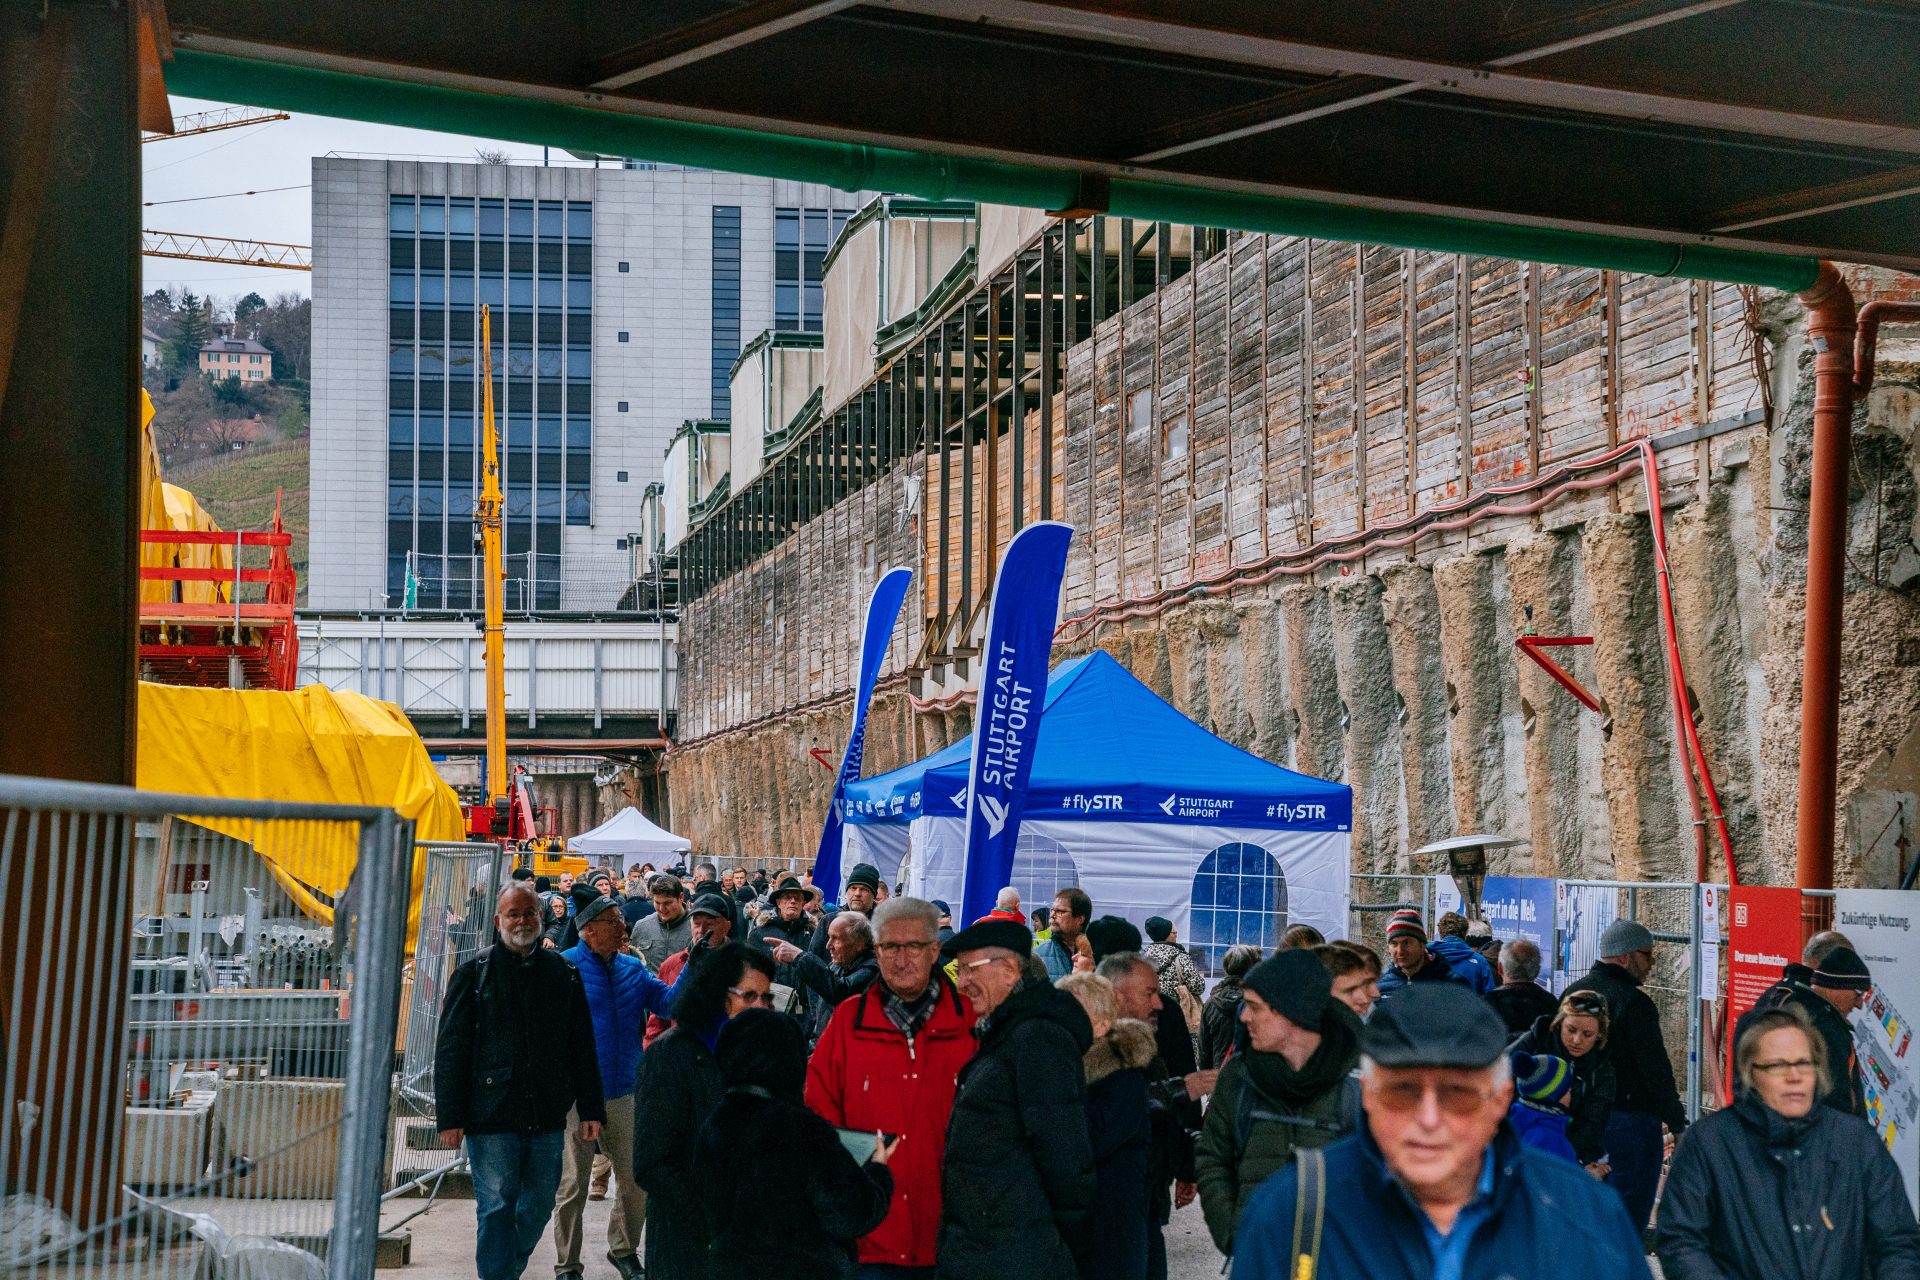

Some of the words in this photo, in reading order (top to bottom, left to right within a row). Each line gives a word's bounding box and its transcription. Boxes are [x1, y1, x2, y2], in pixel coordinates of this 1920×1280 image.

[982, 640, 1016, 786] STUTTGART
[1003, 680, 1033, 790] AIRPORT
[1062, 794, 1123, 813] #flySTR
[1178, 797, 1235, 809] STUTTGART
[1178, 807, 1221, 818] AIRPORT
[1266, 803, 1326, 822] #flySTR
[1501, 898, 1508, 919] in
[1508, 898, 1519, 920] die
[1736, 905, 1747, 925] DB
[1841, 911, 1877, 929] Zukünftige
